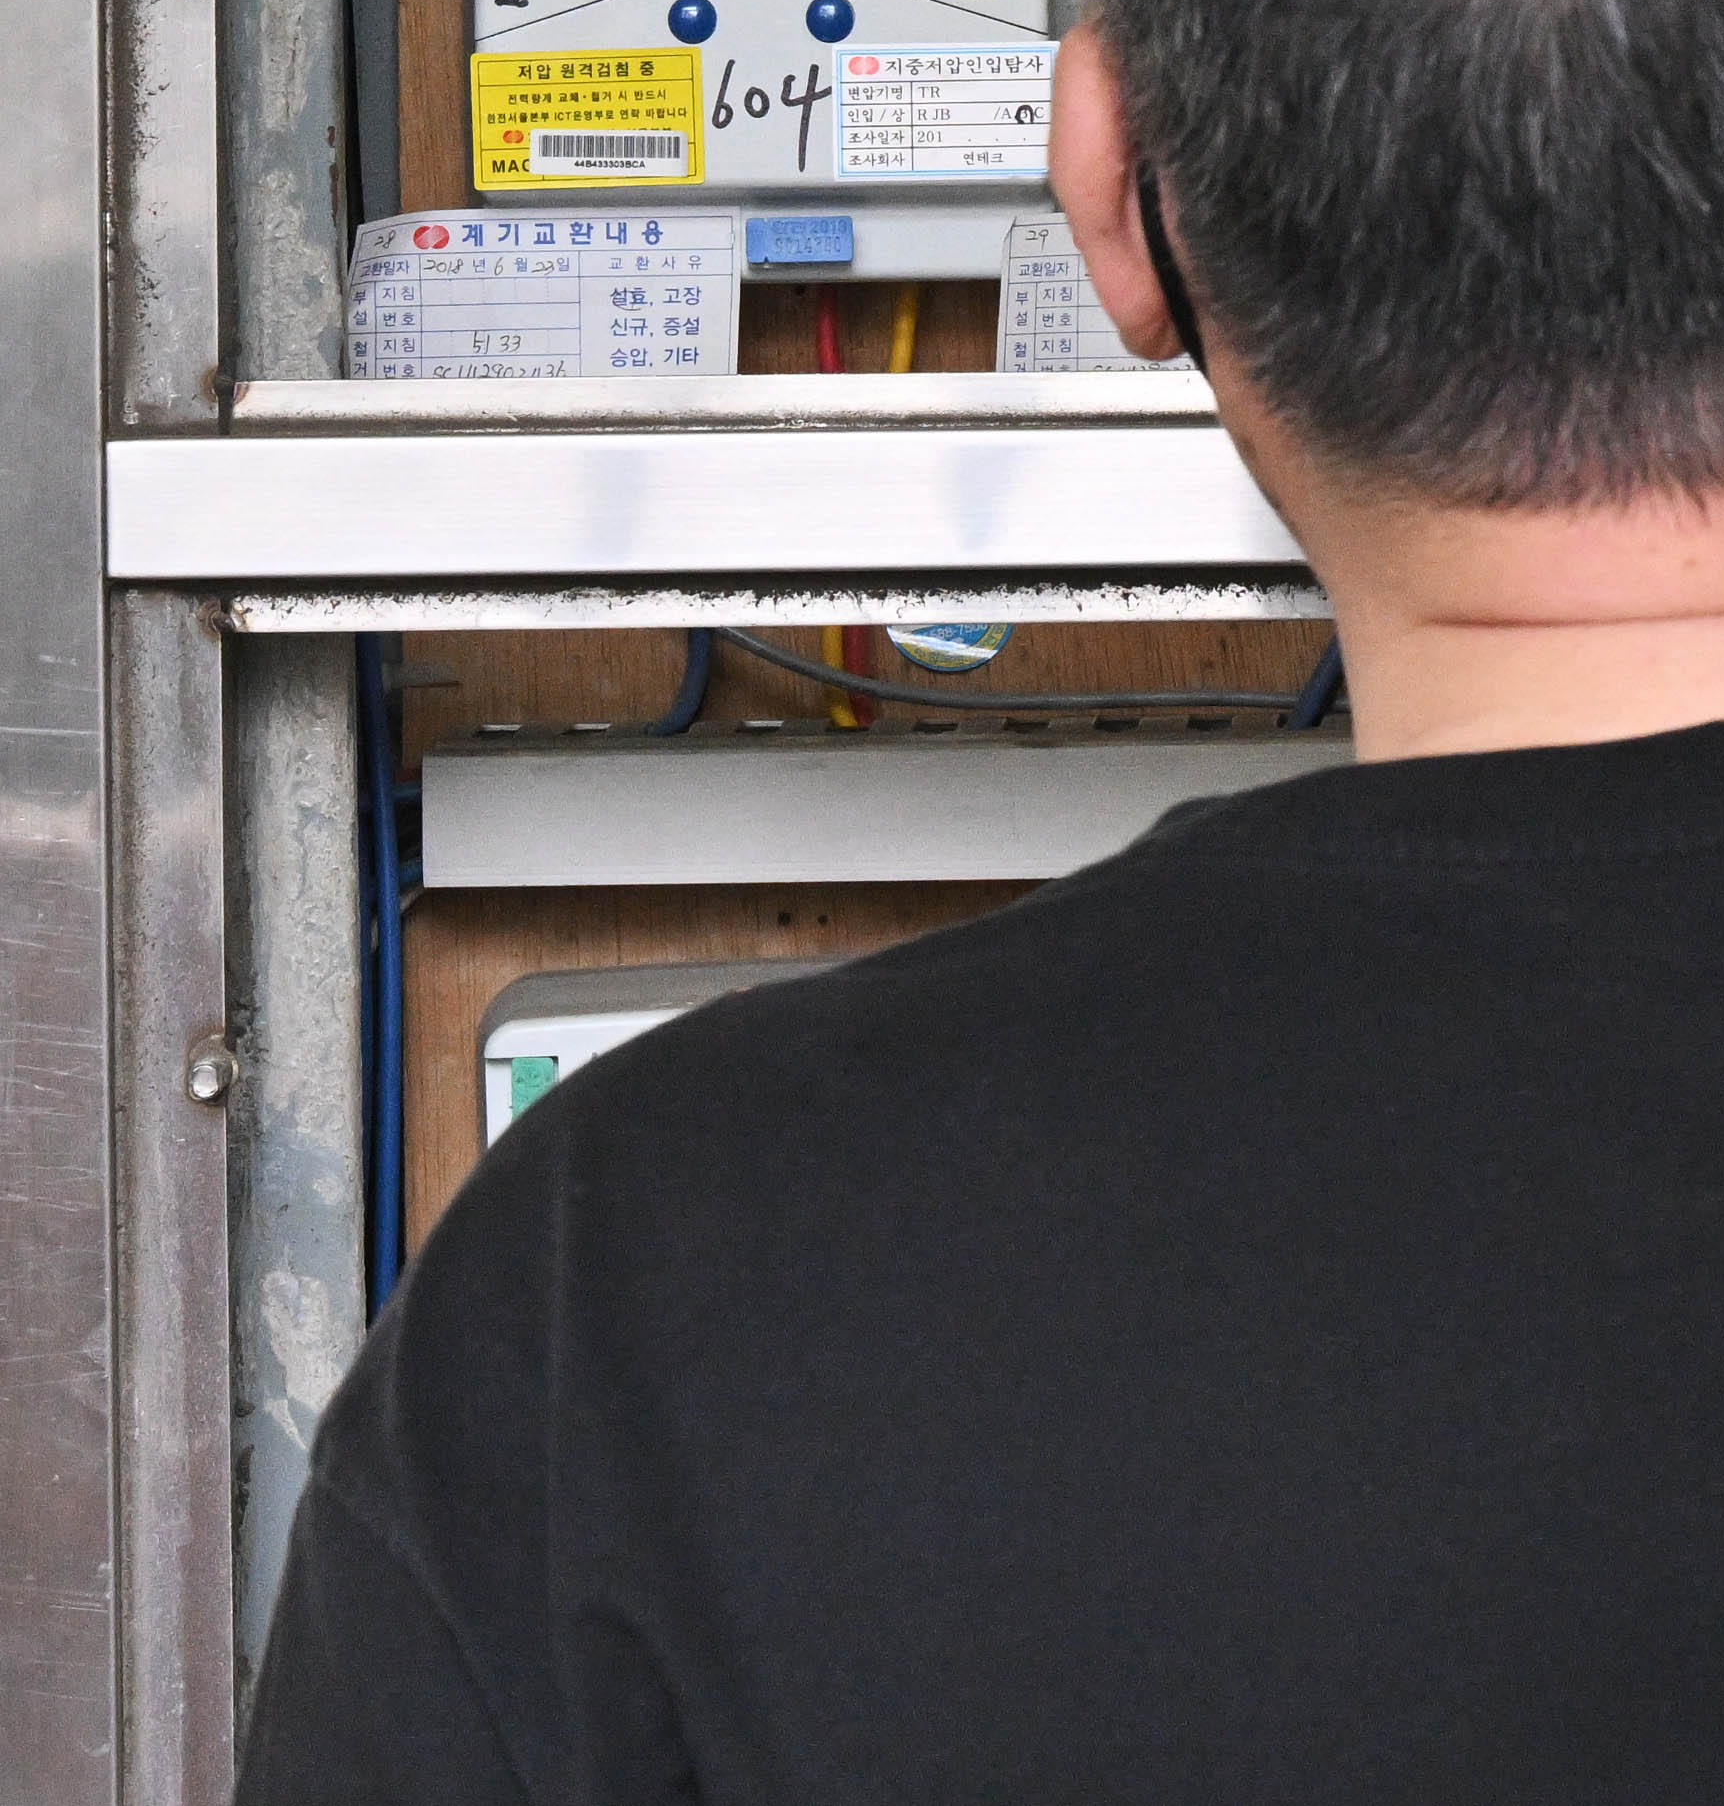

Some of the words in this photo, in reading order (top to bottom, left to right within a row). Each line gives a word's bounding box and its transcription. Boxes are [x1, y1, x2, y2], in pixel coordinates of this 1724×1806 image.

[517, 61, 553, 80] 저압
[640, 59, 655, 78] 중
[711, 60, 832, 173] 604
